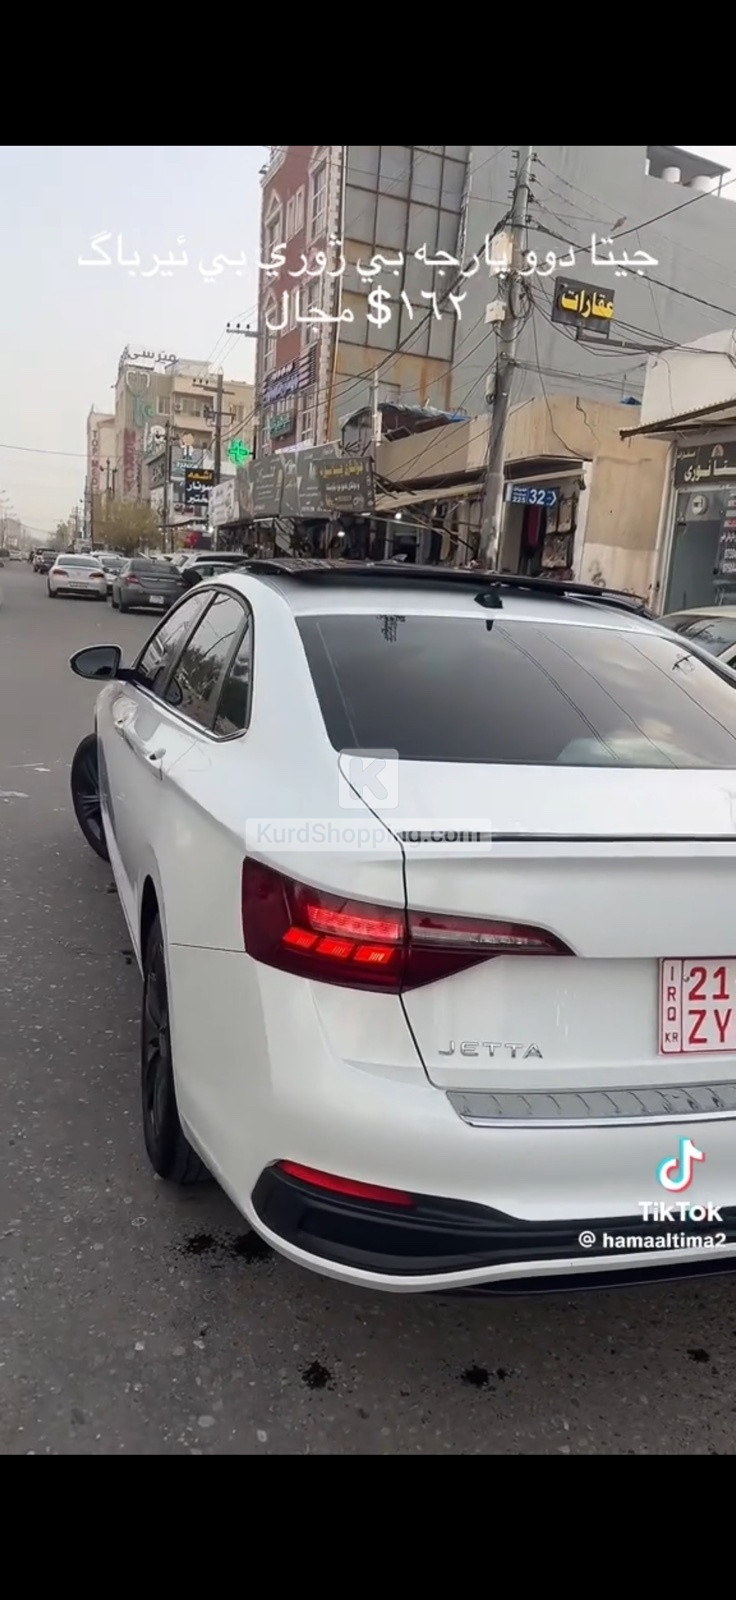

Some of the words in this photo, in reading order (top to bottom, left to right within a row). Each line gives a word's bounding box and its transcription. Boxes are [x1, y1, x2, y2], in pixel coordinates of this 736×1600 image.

[561, 289, 614, 319] عقارات
[187, 494, 209, 504] ختبر
[529, 489, 545, 505] 32
[667, 966, 676, 1021] IRQ
[664, 1032, 679, 1043] KR
[438, 1041, 544, 1060] JETTA
